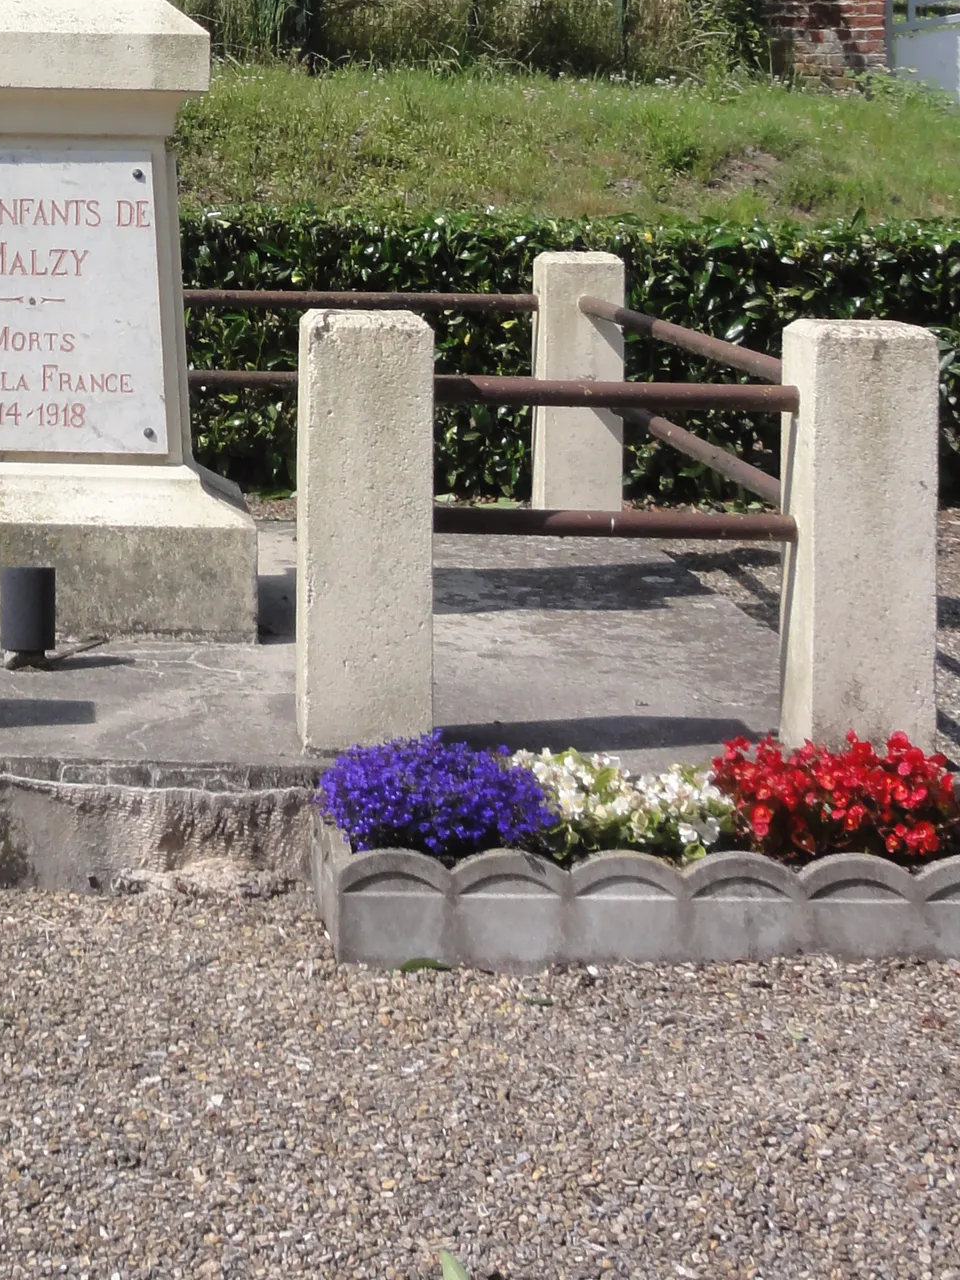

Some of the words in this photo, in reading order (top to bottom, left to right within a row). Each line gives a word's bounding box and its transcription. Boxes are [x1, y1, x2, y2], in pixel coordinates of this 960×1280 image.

[116, 200, 150, 228] DE
[1, 372, 30, 391] LA
[42, 364, 133, 393] FRANCE
